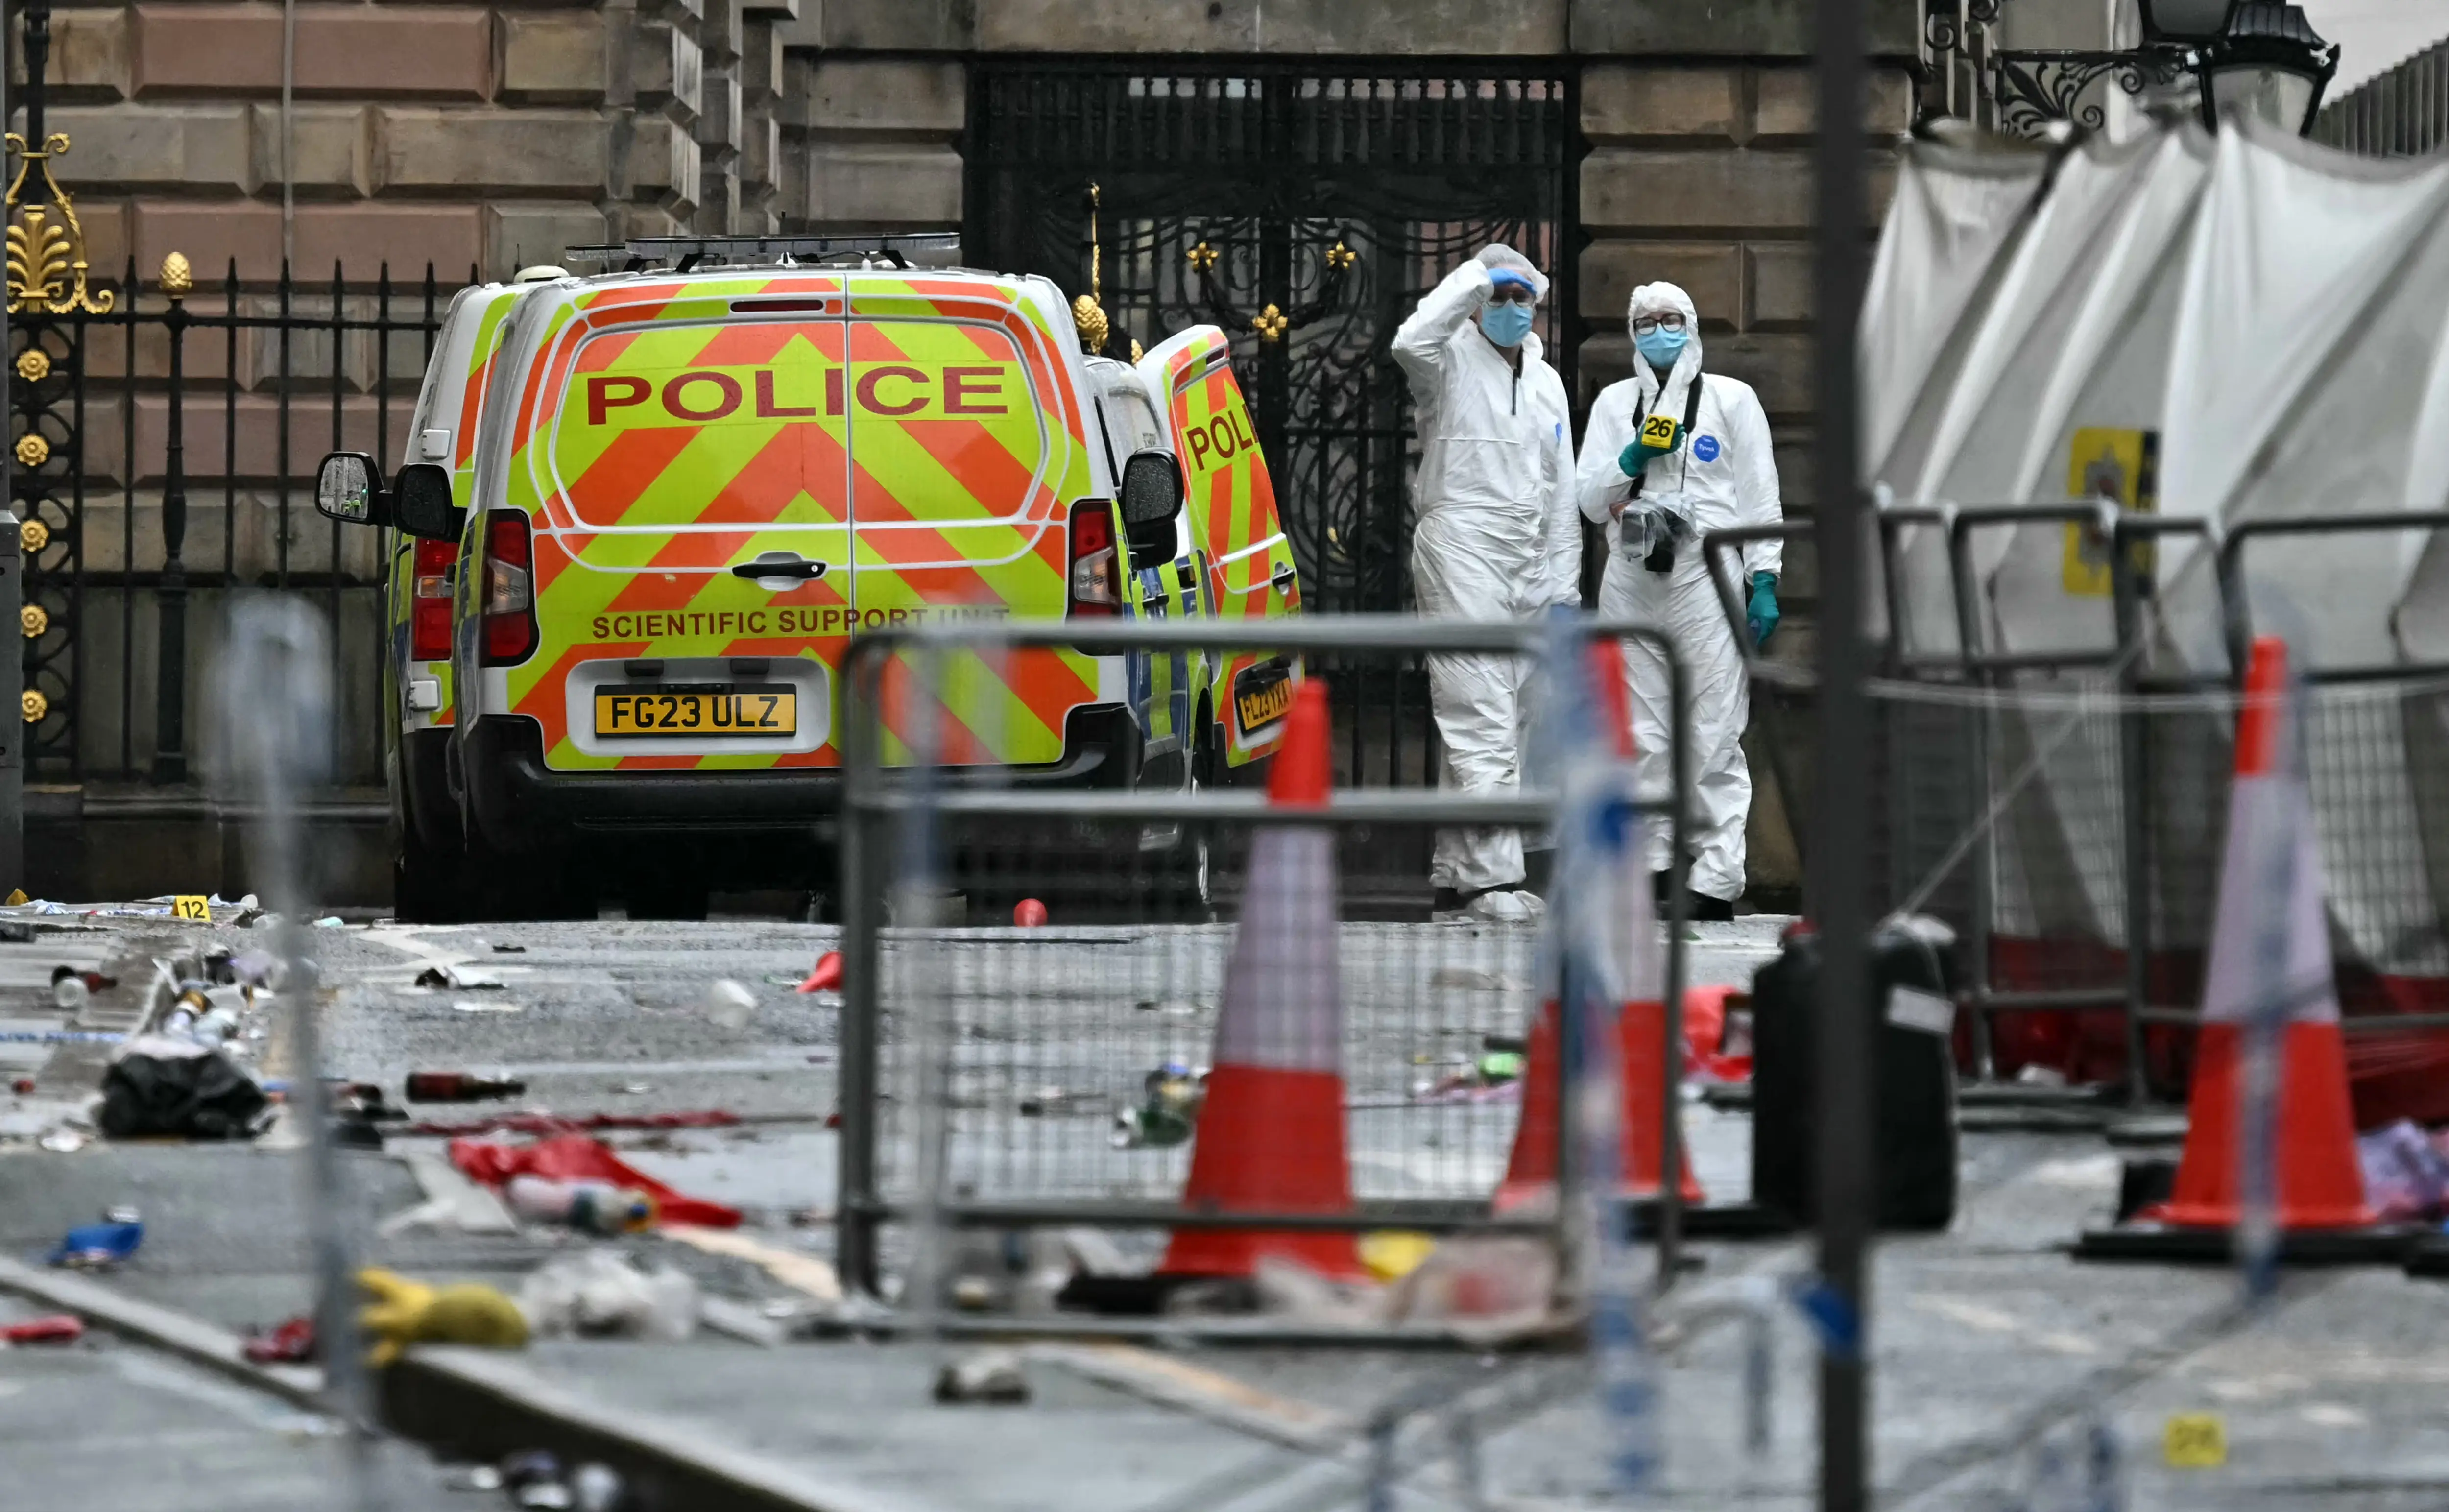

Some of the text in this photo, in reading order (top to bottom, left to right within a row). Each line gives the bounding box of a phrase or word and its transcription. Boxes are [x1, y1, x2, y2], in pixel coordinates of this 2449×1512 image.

[587, 366, 1008, 426] POLICE
[1186, 403, 1259, 471] POLI
[1645, 417, 1672, 438] 26
[592, 608, 1010, 639] SCIENTIFIC SUPPORT UNT
[611, 696, 779, 728] FG23 ULZ
[181, 900, 206, 919] 12
